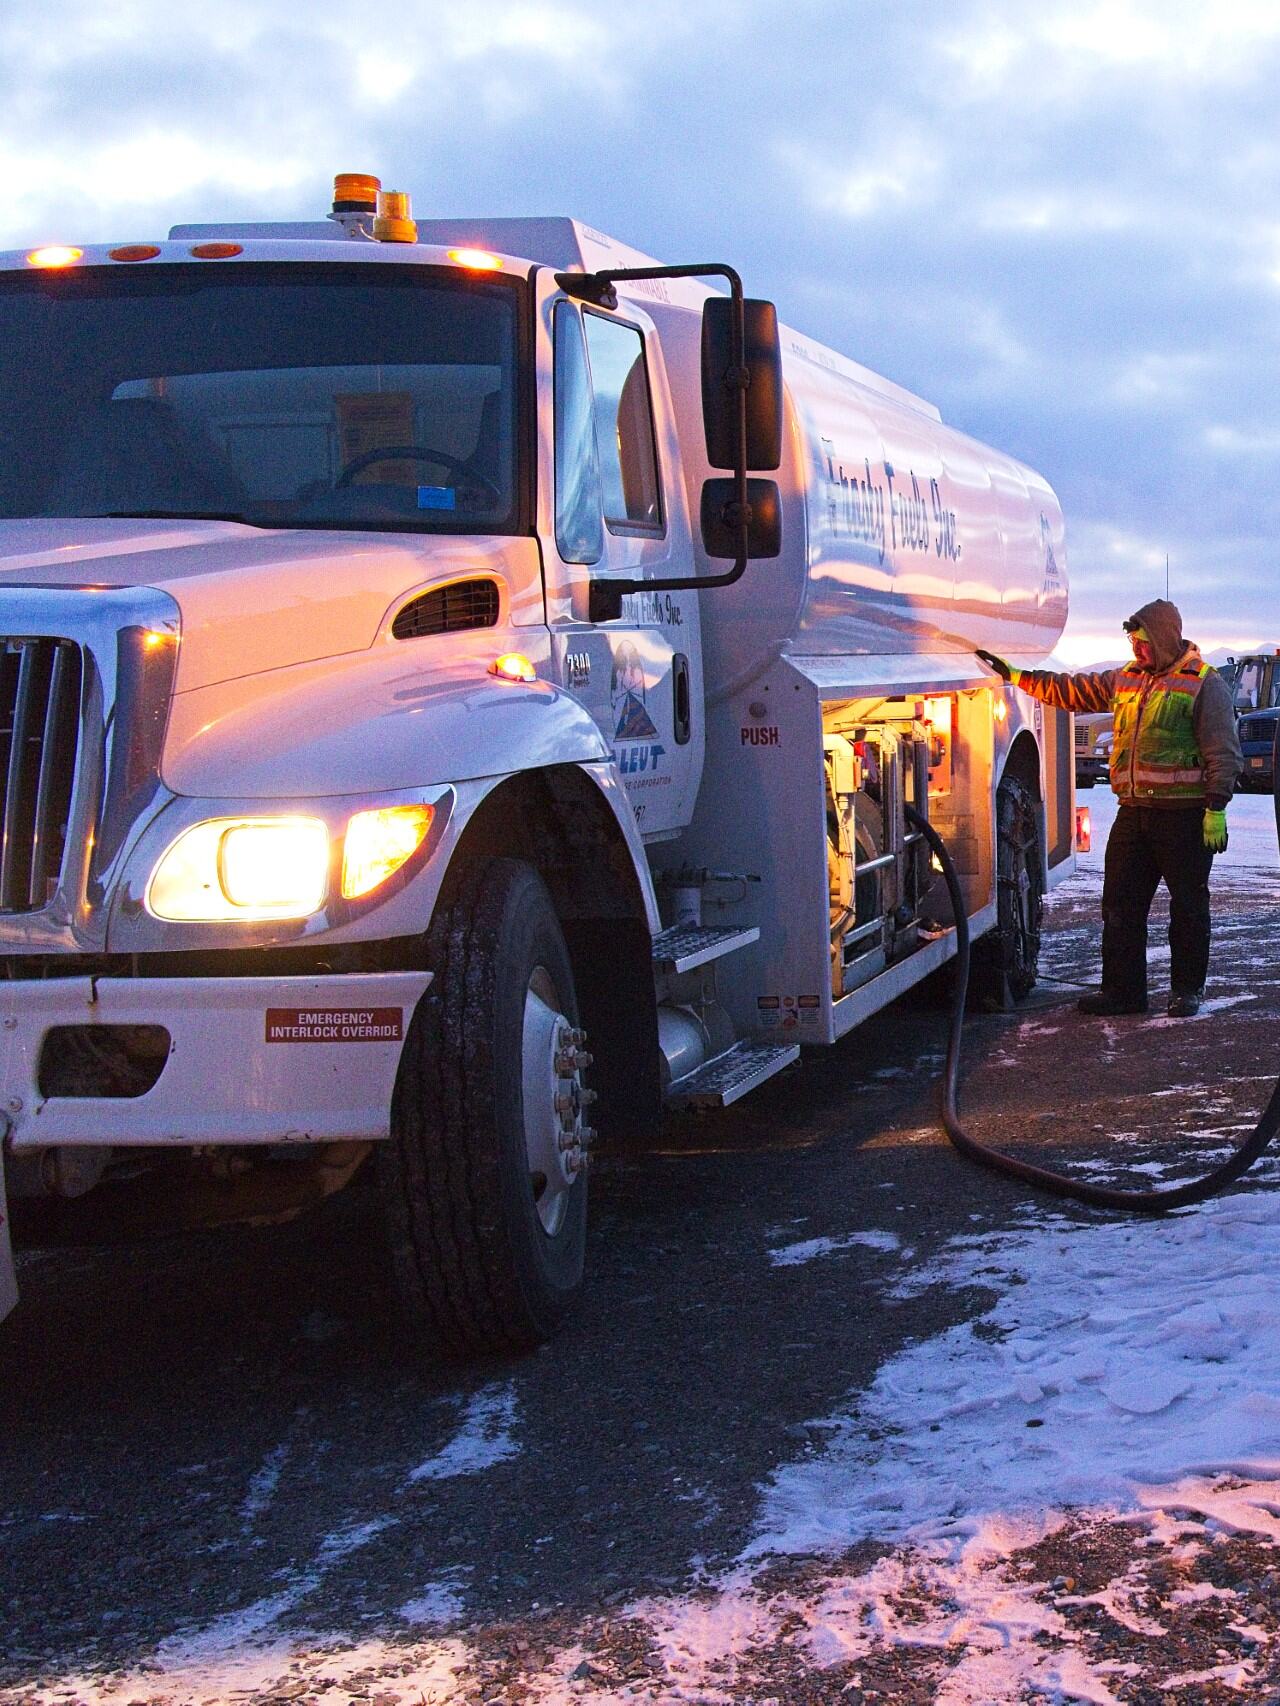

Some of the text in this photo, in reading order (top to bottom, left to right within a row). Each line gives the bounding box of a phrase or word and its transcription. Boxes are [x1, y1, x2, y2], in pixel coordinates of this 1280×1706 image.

[741, 727, 778, 746] PUSH
[620, 745, 666, 774] LEUT
[298, 1012, 374, 1025] EMERGENCY
[271, 1025, 398, 1038] INTERLOCK OVERRIDE
